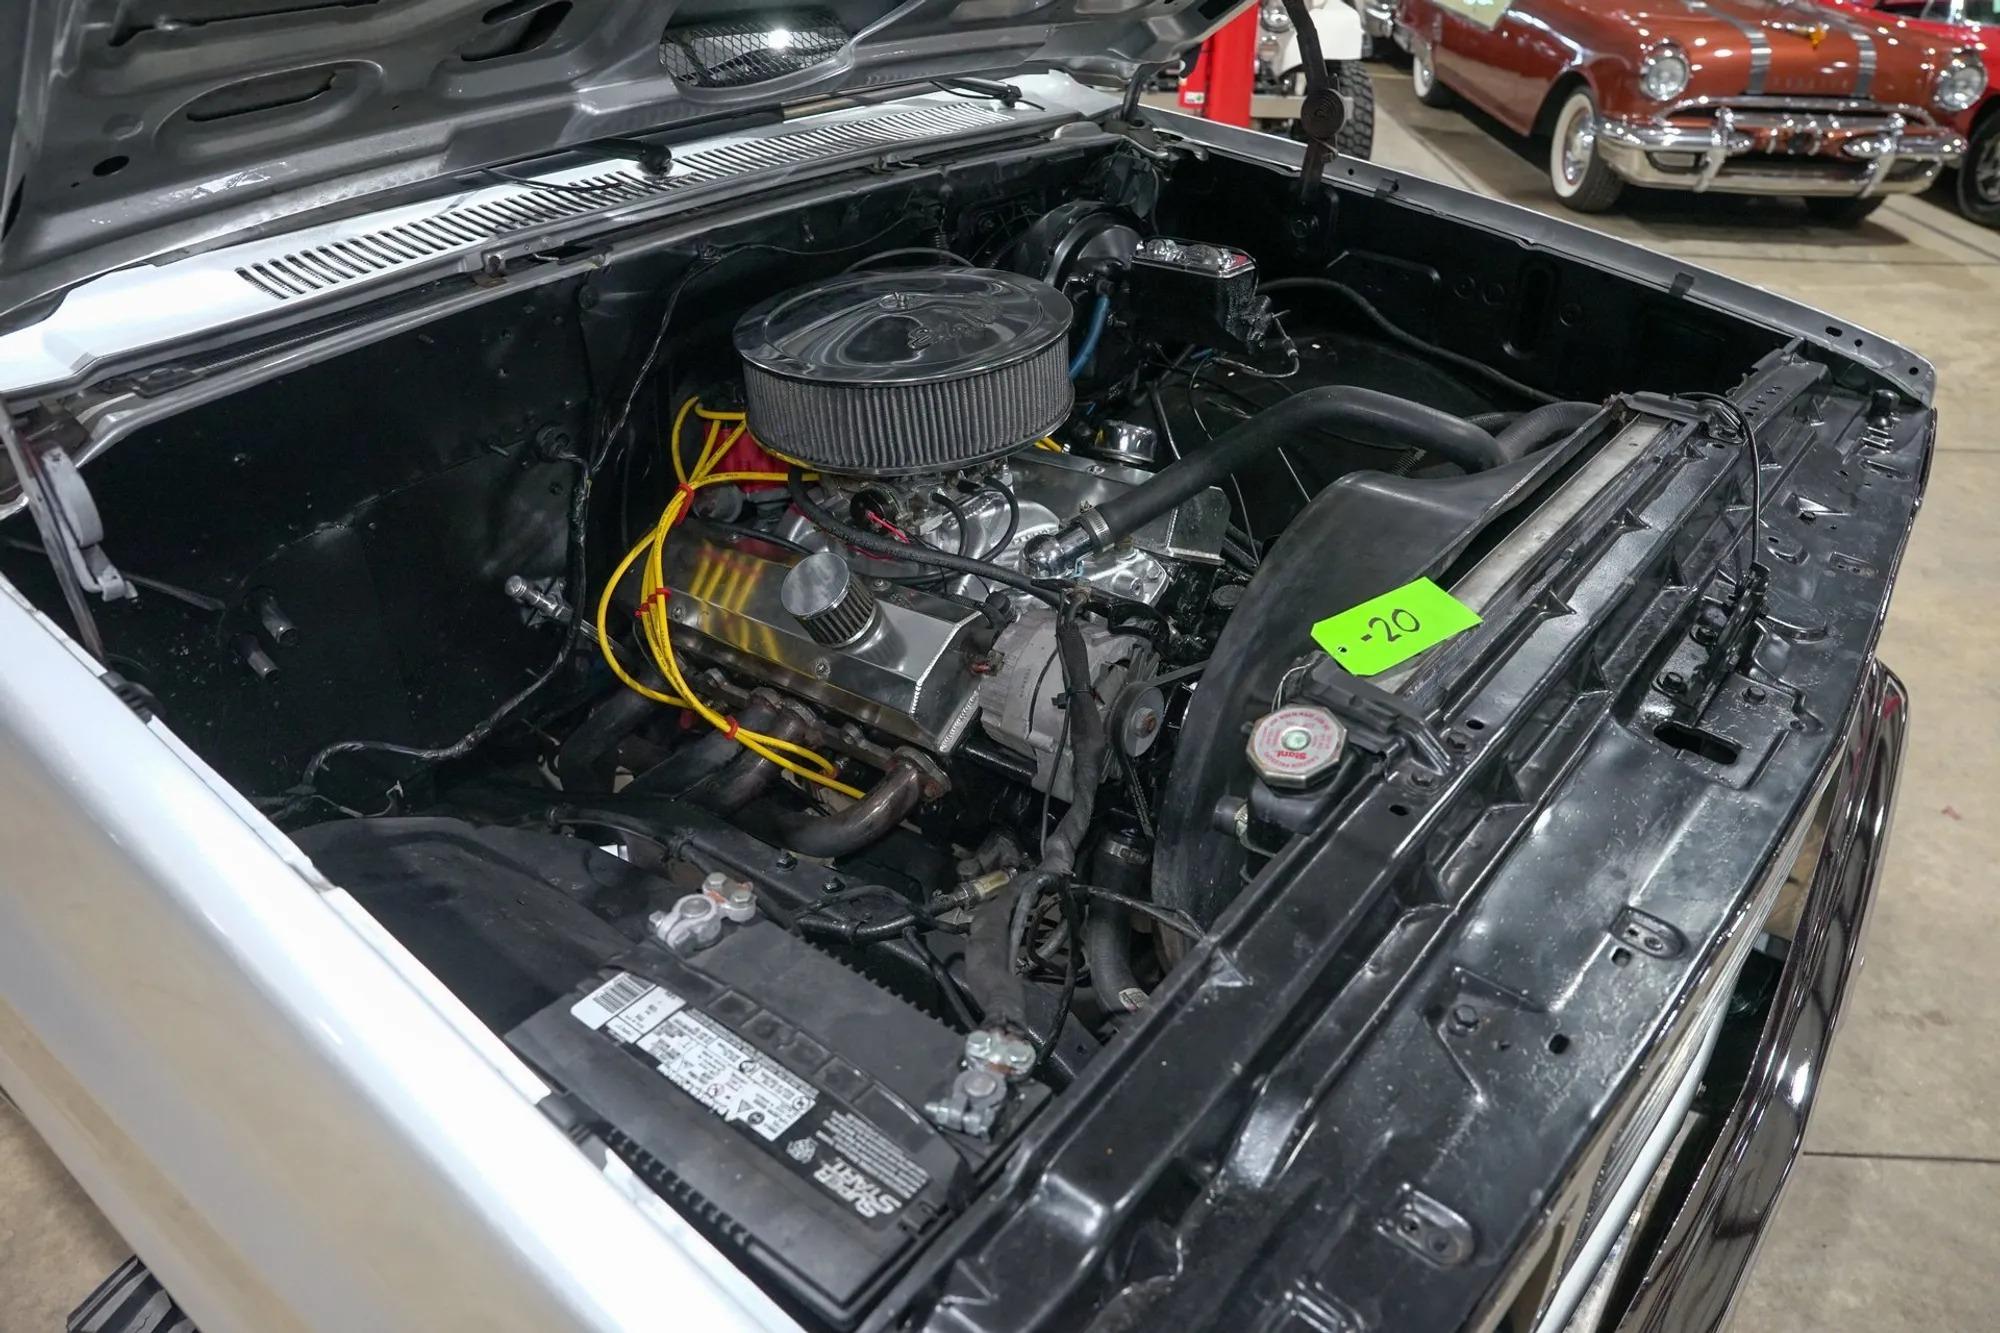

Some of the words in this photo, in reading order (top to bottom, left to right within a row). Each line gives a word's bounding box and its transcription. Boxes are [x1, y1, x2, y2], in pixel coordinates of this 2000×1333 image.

[1361, 609, 1420, 642] -20
[813, 1160, 878, 1218] SUPER
[829, 1157, 902, 1214] START
